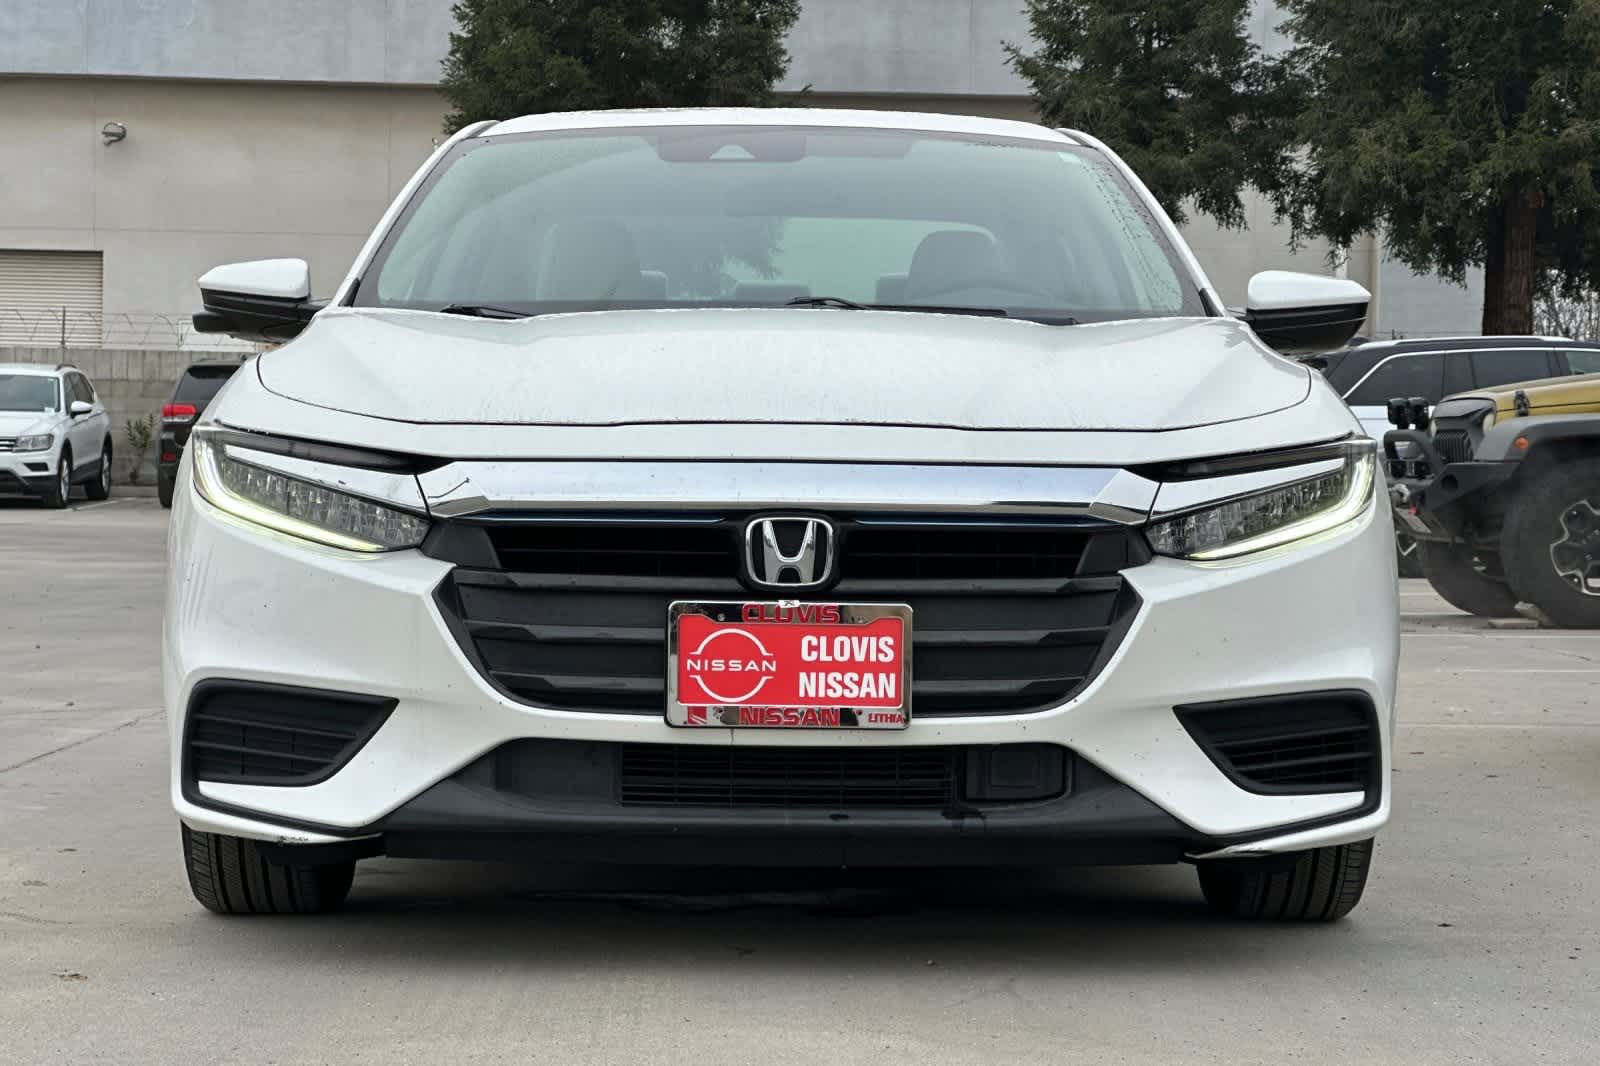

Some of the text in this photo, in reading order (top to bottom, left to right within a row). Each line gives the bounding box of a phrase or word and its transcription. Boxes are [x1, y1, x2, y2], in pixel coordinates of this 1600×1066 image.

[801, 635, 895, 663] CLOVIS
[686, 659, 777, 672] NISSAN
[799, 672, 896, 699] NISSAN
[740, 707, 840, 726] NISSAN
[868, 713, 903, 724] LITHIA
